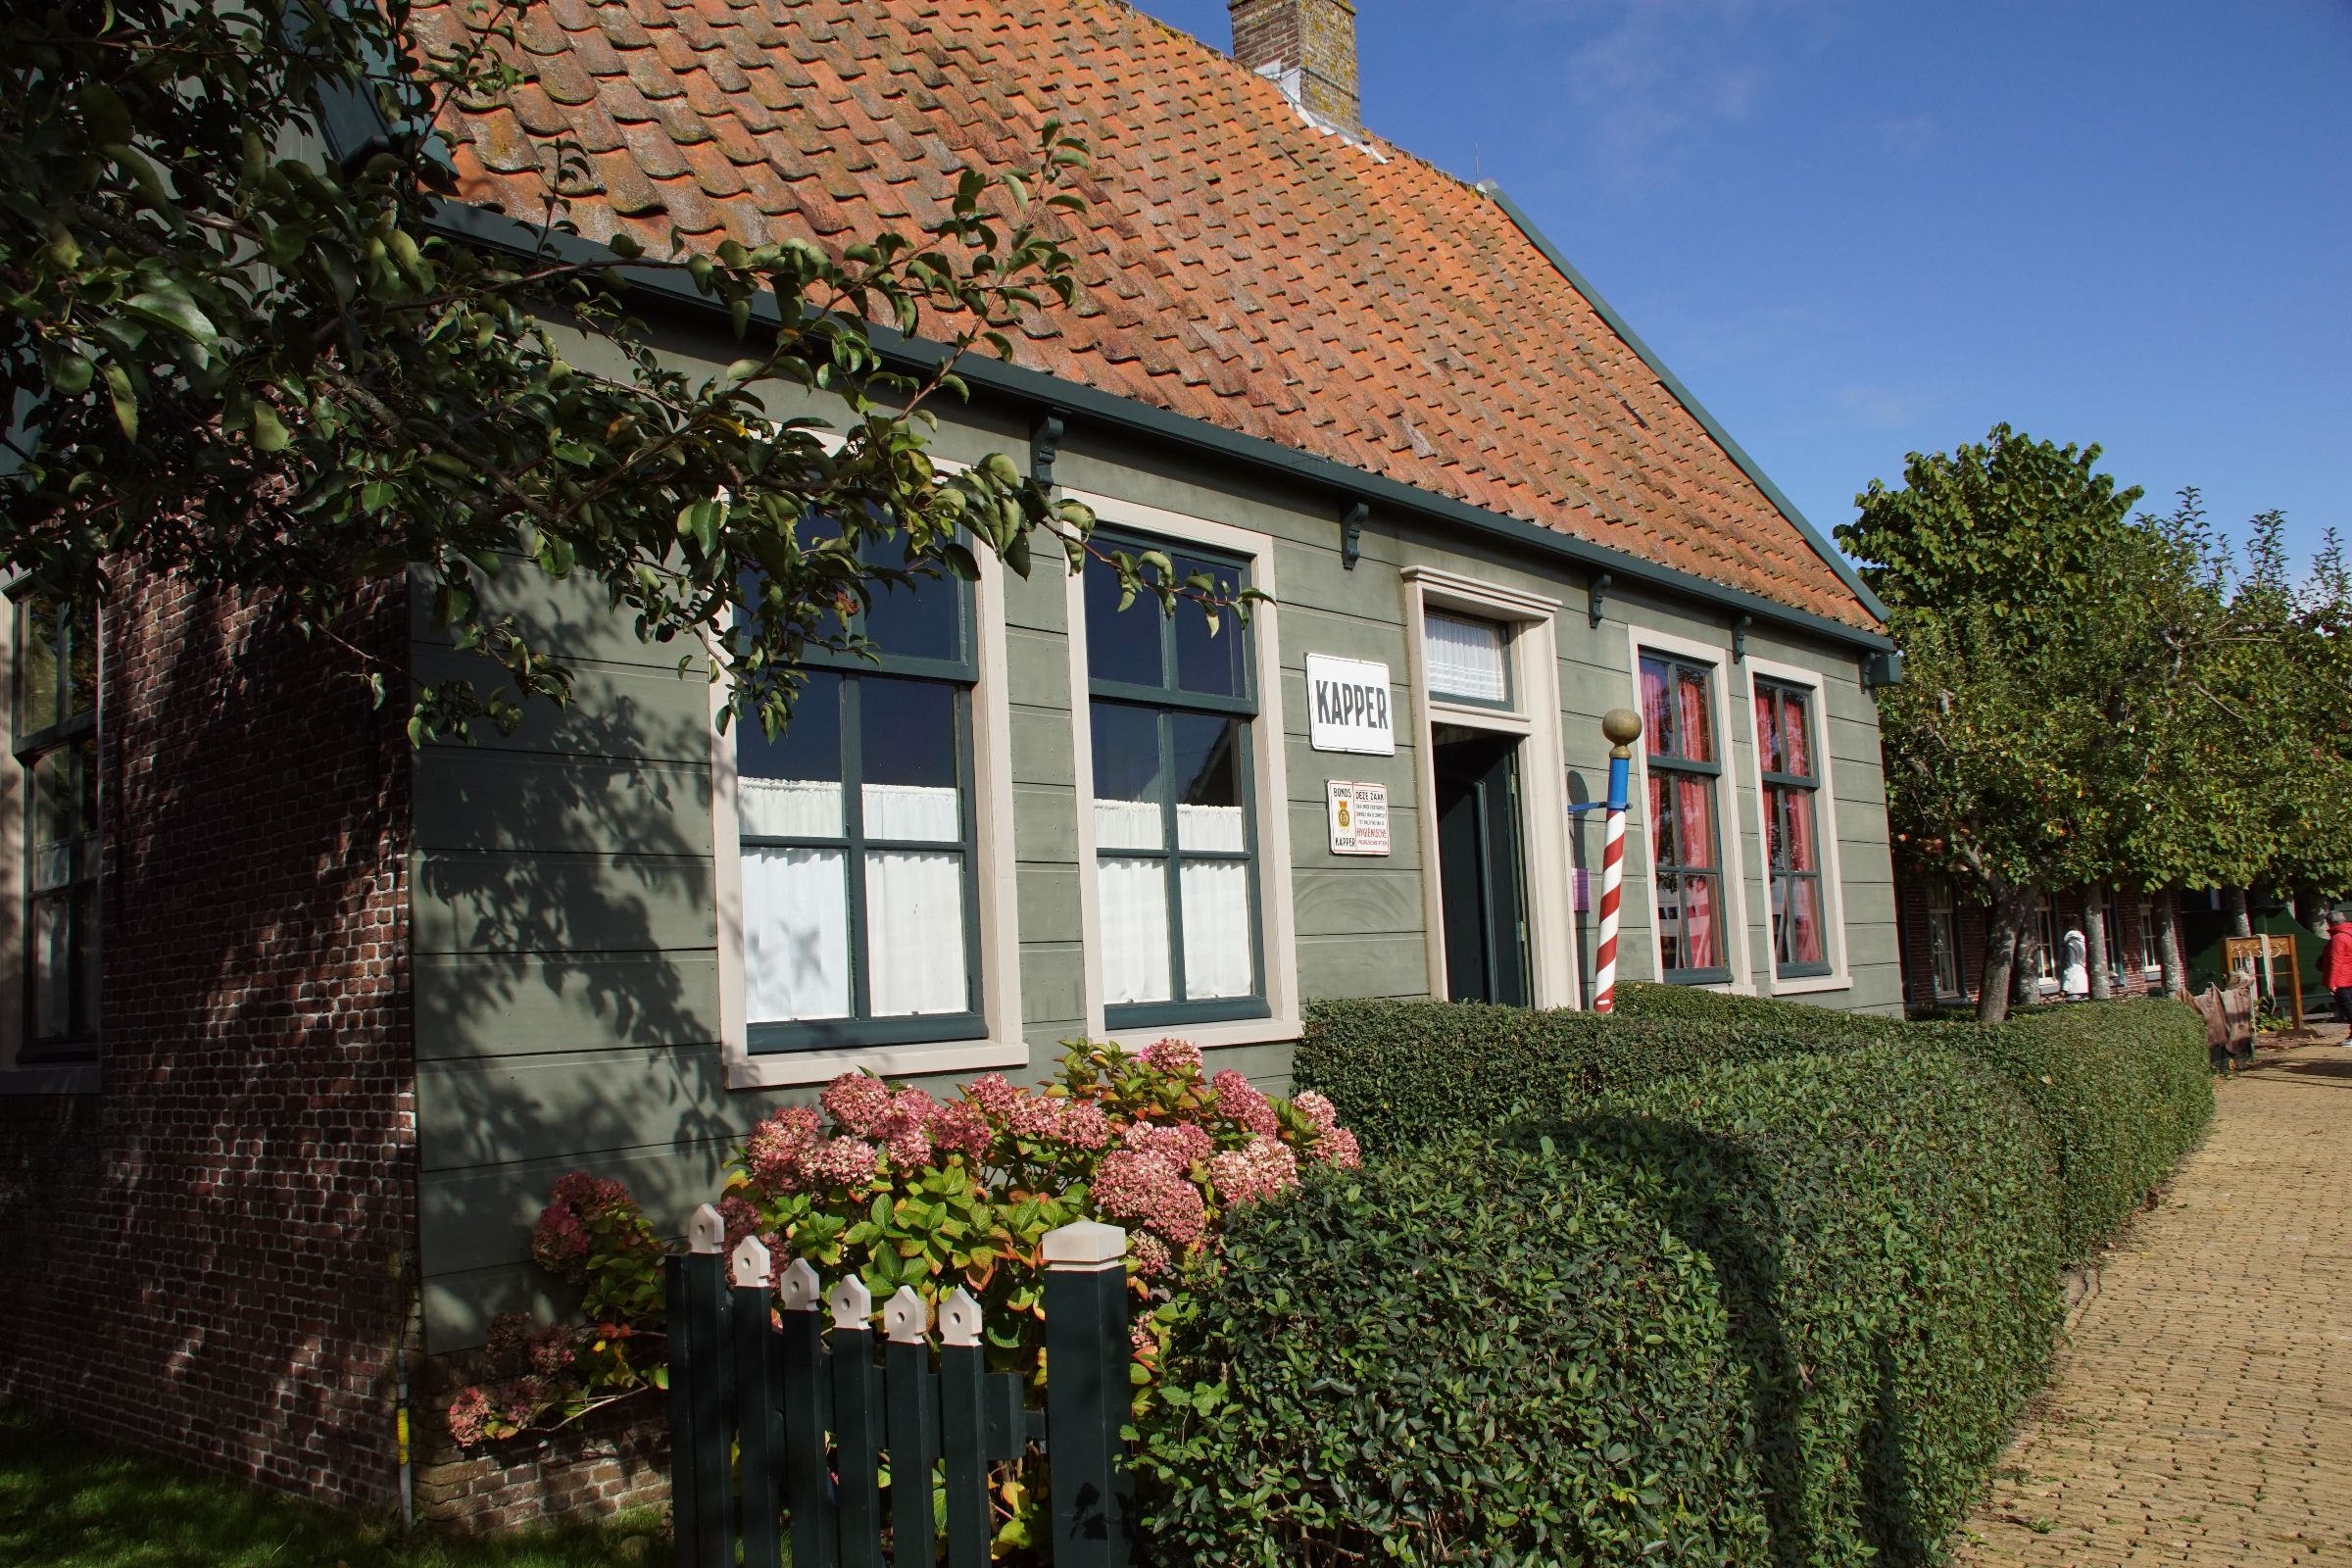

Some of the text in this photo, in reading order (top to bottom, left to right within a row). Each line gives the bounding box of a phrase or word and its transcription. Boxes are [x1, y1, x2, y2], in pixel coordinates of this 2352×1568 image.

[1315, 679, 1389, 730] KAPPER
[1333, 787, 1352, 798] BONDS
[1355, 791, 1384, 802] DEZE ZAAK
[1335, 837, 1356, 848] KAPPER
